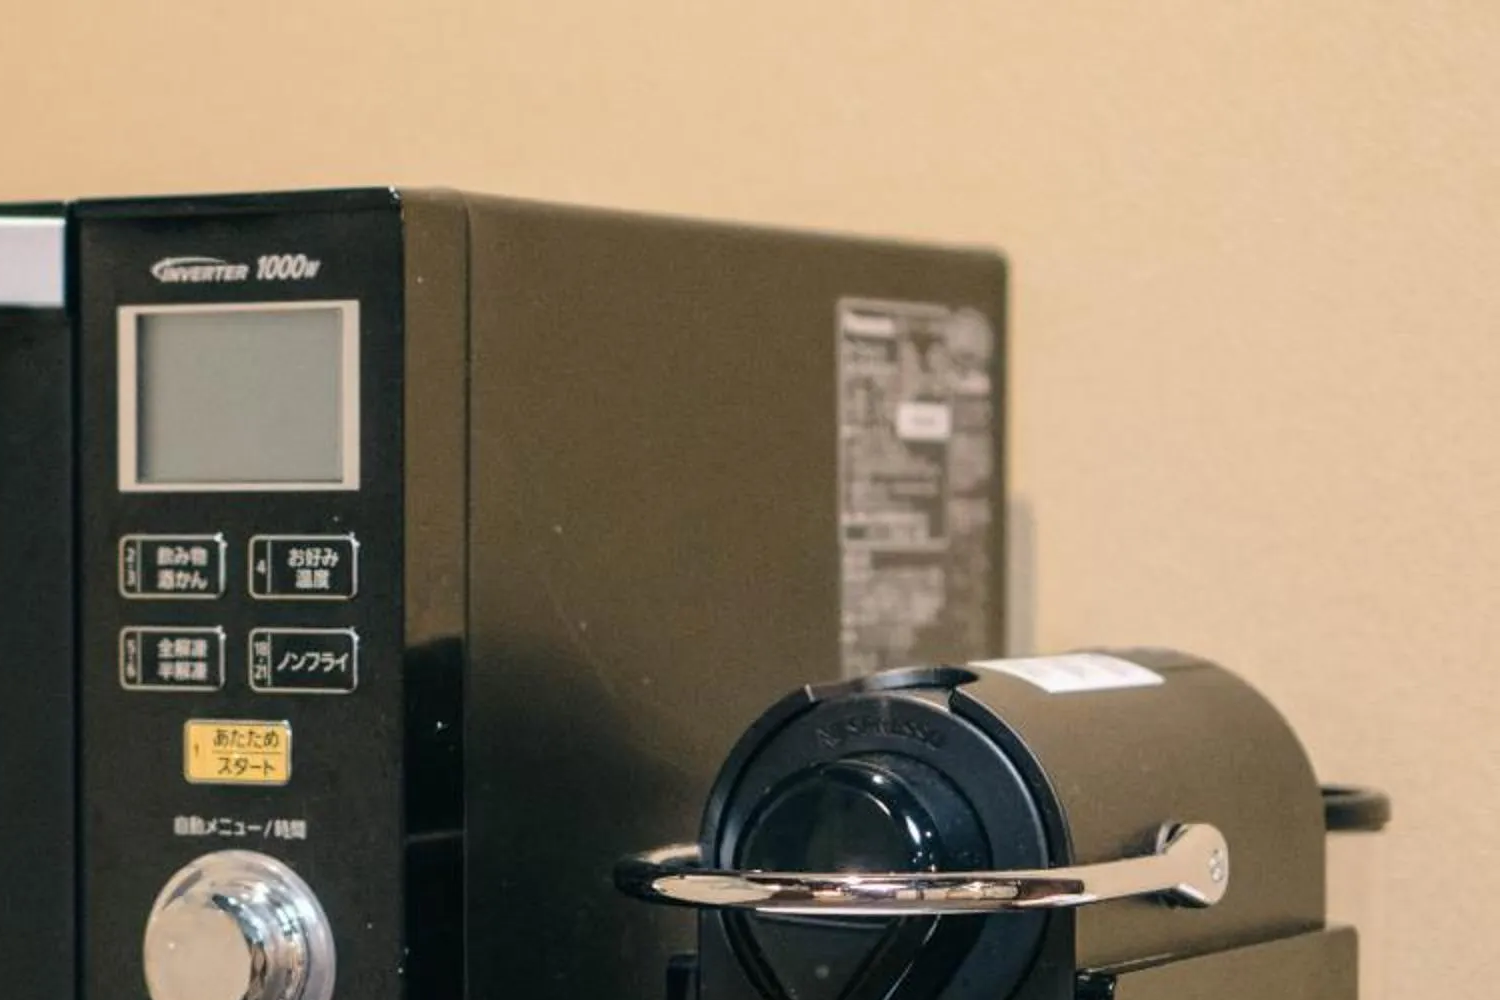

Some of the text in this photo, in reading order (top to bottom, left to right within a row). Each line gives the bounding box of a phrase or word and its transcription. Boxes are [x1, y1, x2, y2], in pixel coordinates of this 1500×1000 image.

[159, 262, 249, 282] INVERTER
[256, 559, 266, 575] 4
[287, 547, 339, 568] お好み
[277, 651, 349, 672] ノンフライ
[213, 728, 280, 749] あたため
[217, 756, 276, 777] スタート
